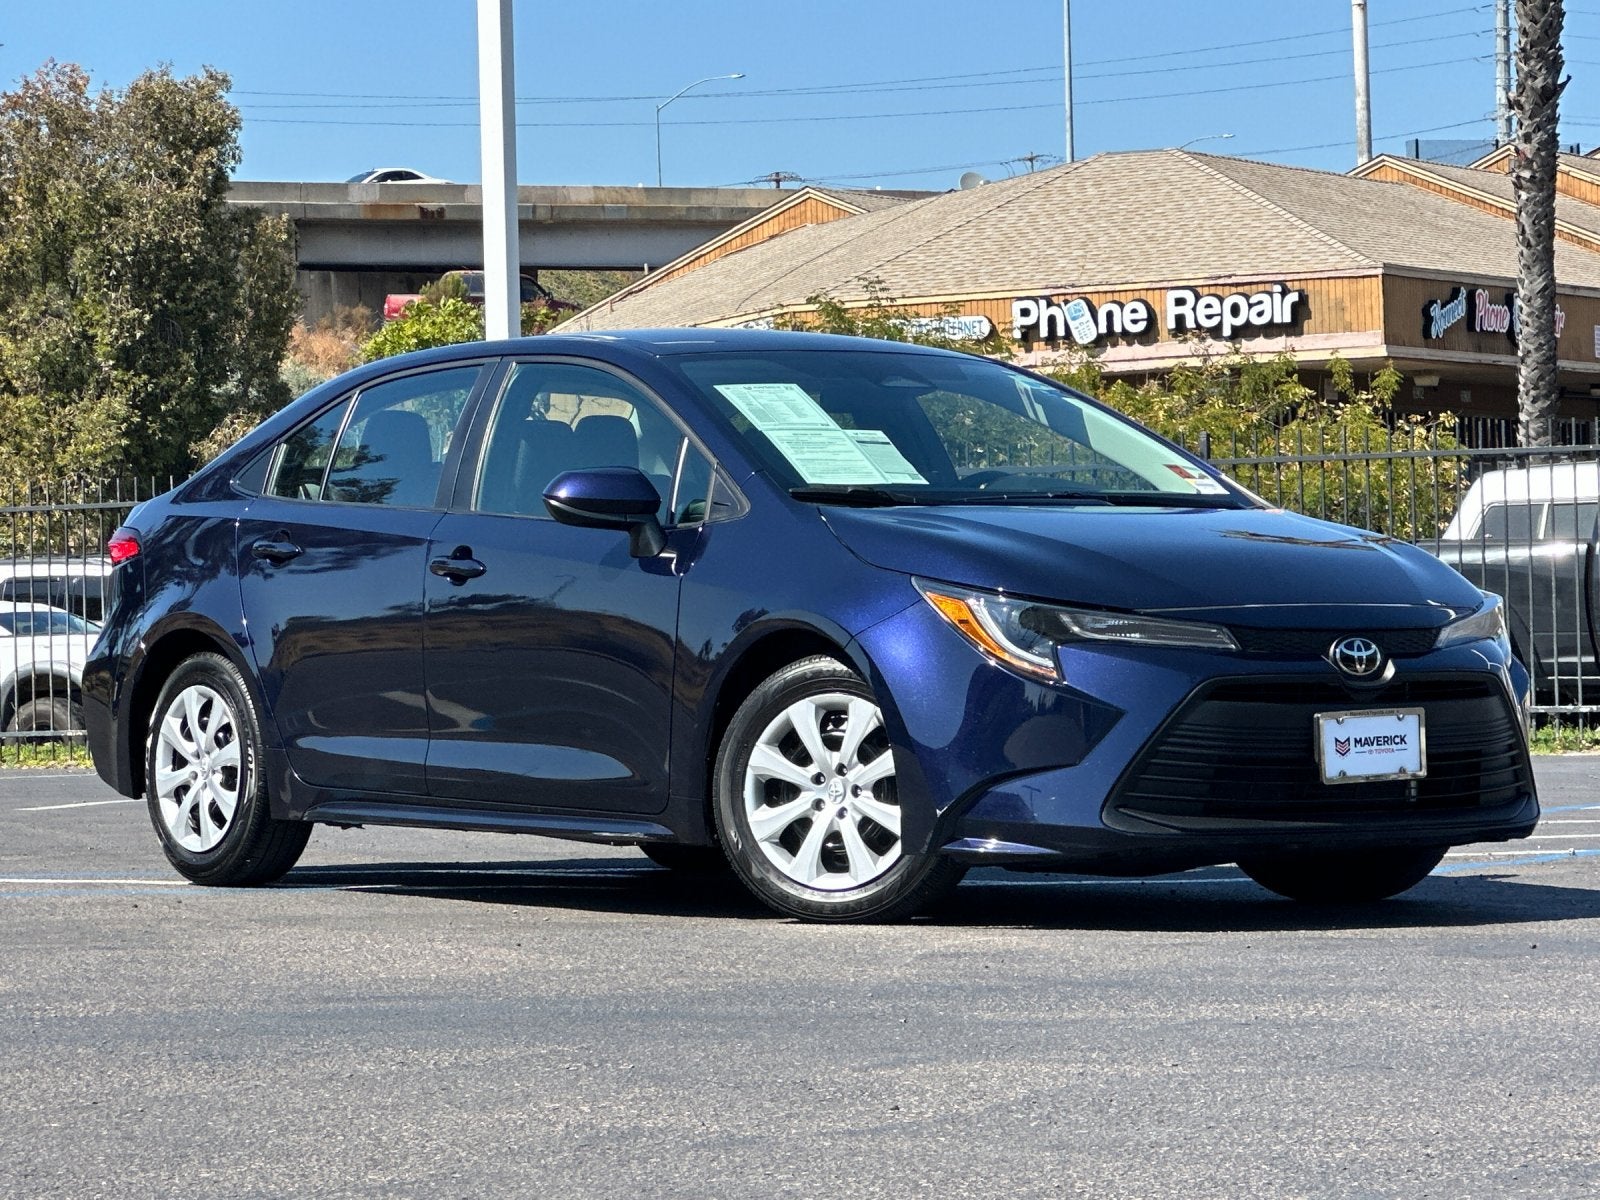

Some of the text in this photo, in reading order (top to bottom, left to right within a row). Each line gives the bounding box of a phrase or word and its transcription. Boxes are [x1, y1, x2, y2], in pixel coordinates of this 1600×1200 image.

[1011, 284, 1300, 345] Phone Repair
[1475, 288, 1511, 333] Phone
[1353, 734, 1408, 748] MAVERICK
